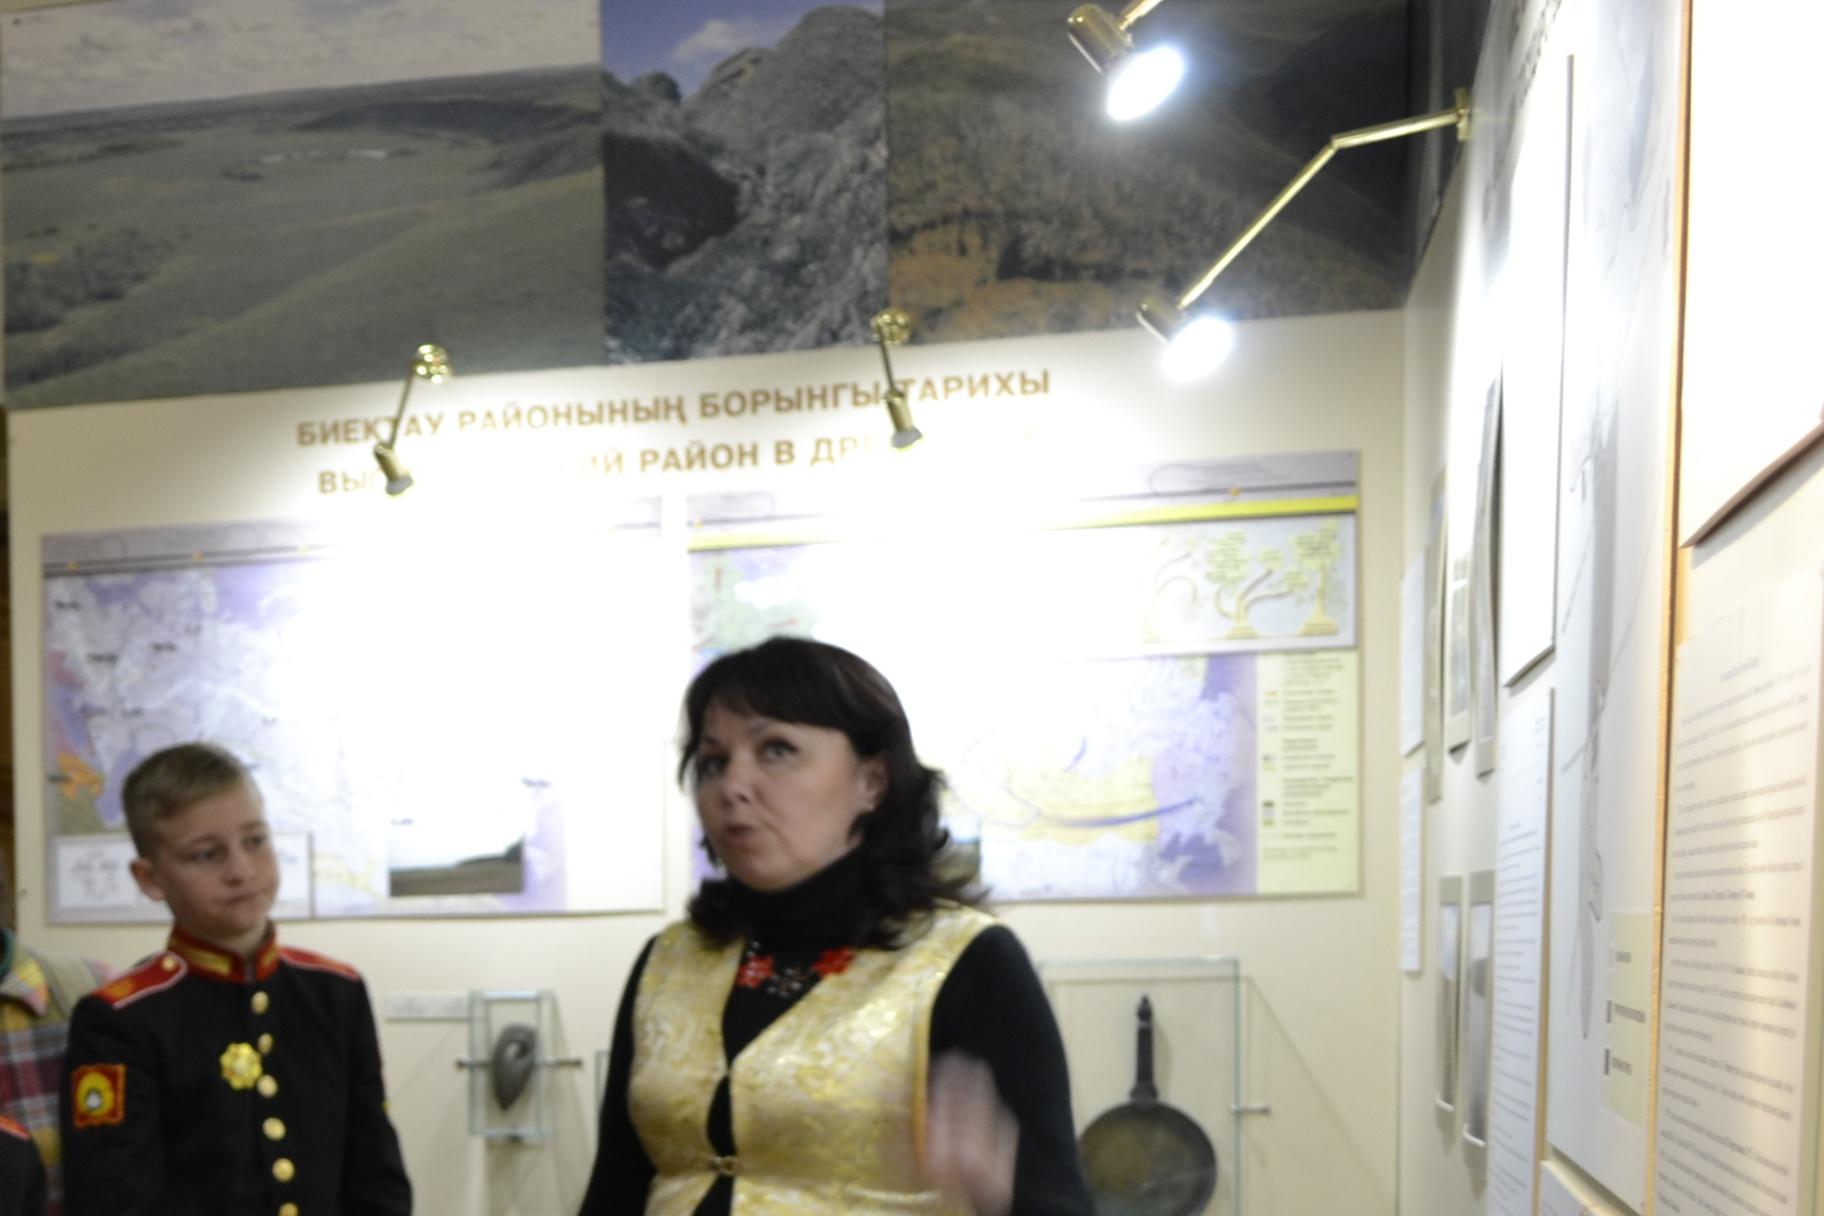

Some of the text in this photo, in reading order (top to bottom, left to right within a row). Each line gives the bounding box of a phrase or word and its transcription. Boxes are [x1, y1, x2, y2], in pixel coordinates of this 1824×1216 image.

[699, 382, 880, 418] БОРЫНГЫ
[639, 439, 759, 472] РАЙОН
[773, 439, 795, 465] В
